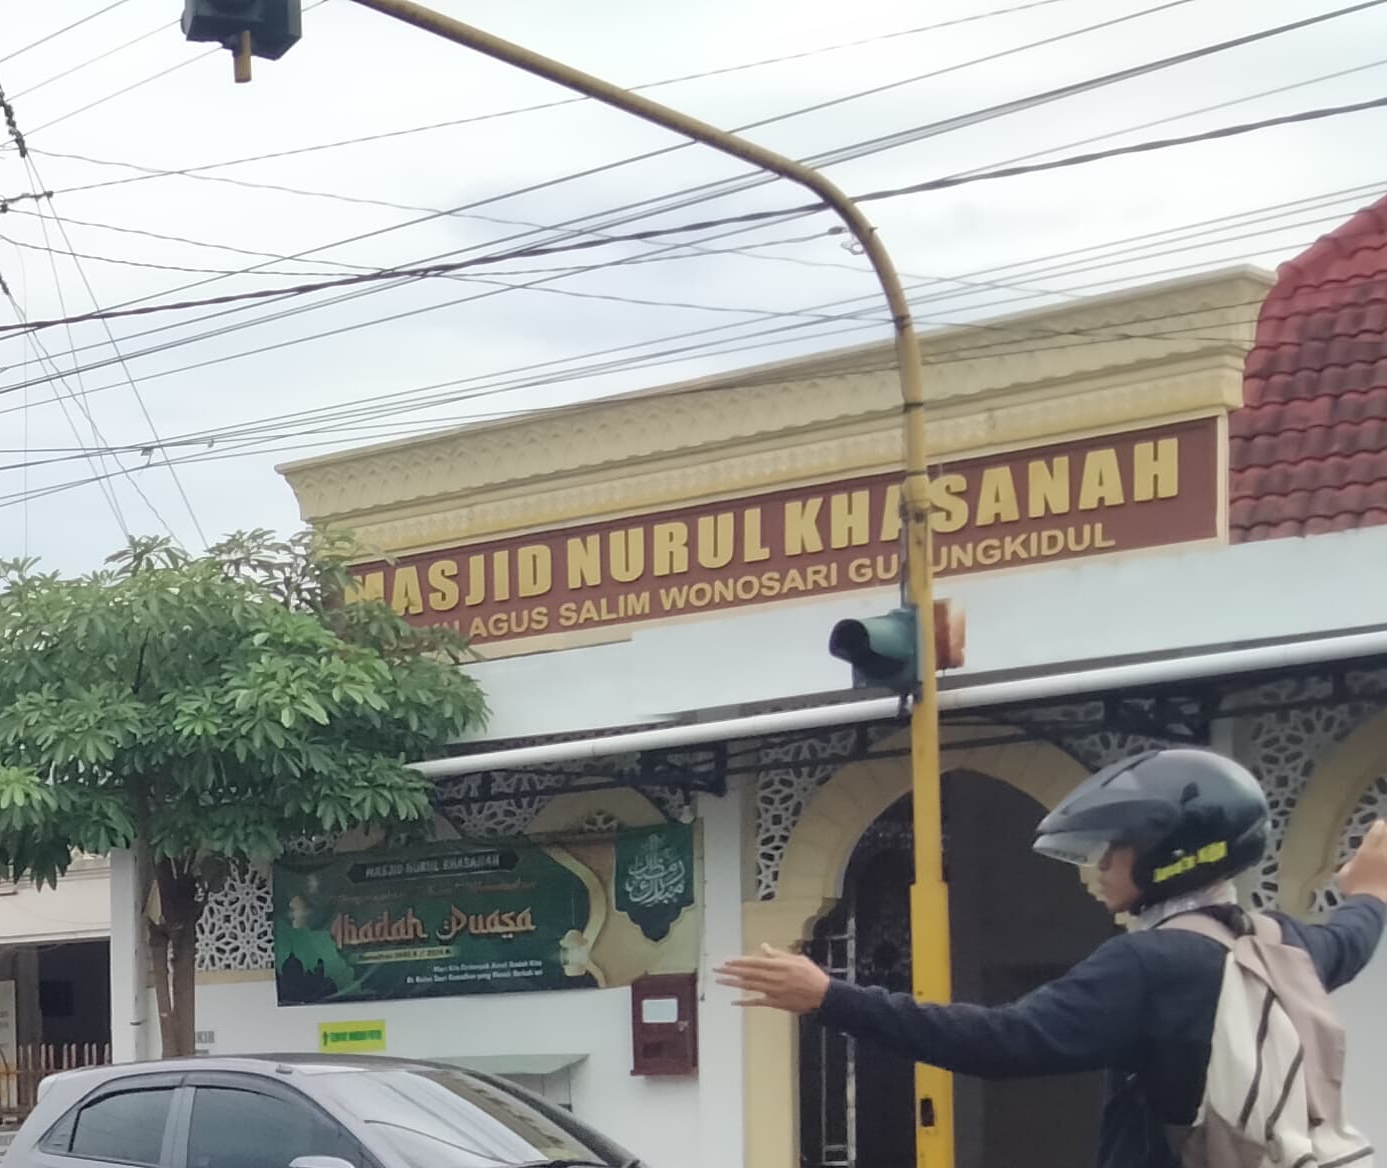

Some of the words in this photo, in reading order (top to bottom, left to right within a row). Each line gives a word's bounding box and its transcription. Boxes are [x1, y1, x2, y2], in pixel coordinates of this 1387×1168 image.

[343, 544, 553, 617] MASJID
[567, 507, 770, 592] NURUL
[784, 437, 1180, 557] KHASANAH
[470, 608, 548, 639] AGUS
[559, 590, 651, 628] SALIM
[659, 562, 838, 611] WONOSARI
[848, 522, 1116, 583] GUUNGKIDUL
[435, 904, 537, 943] Puasa
